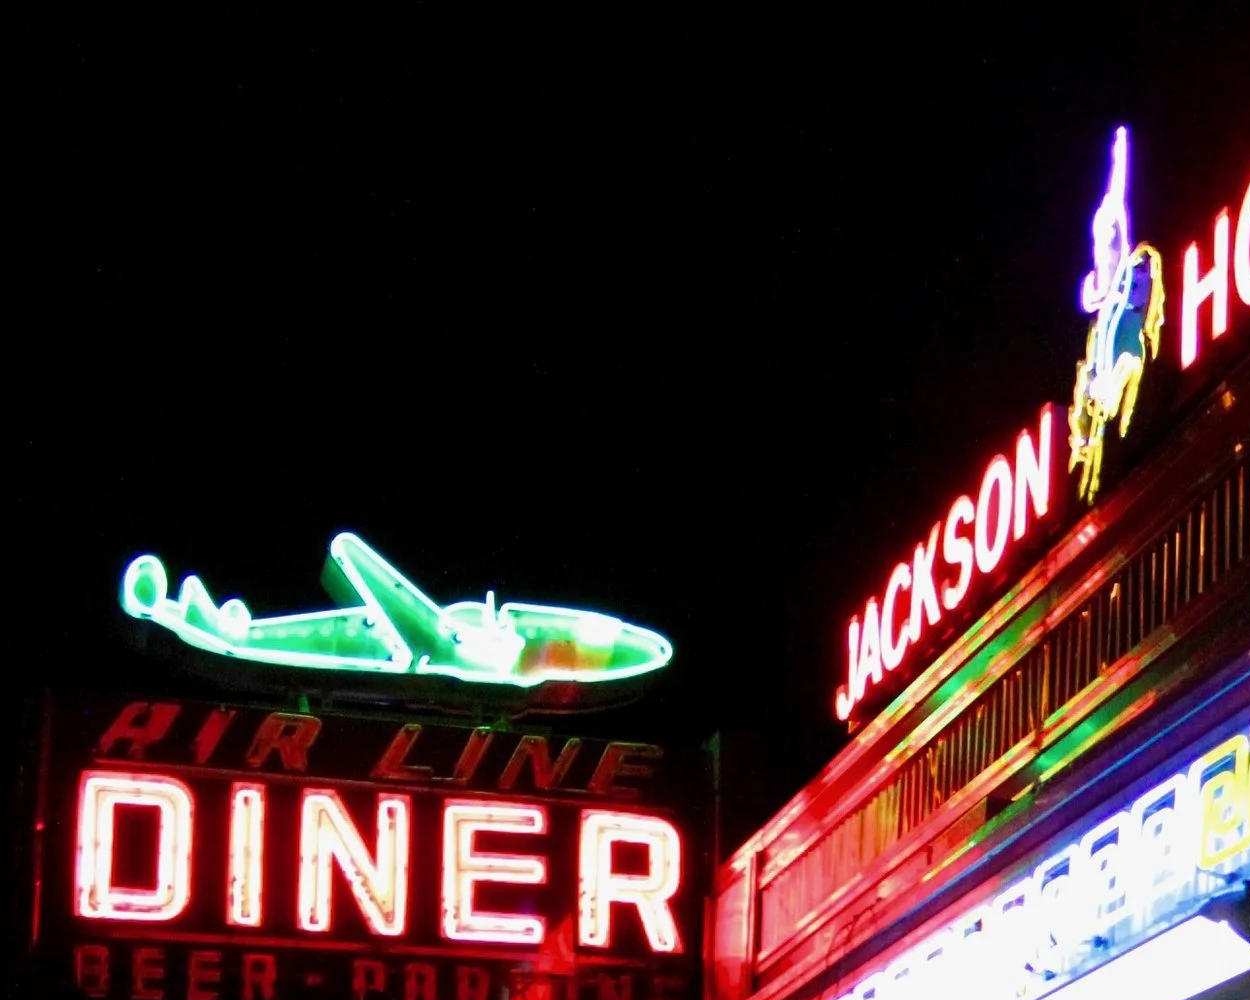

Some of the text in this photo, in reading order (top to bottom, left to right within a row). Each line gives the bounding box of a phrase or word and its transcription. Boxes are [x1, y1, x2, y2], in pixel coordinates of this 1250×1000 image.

[836, 401, 1056, 721] JACKSON
[98, 699, 664, 795] AIR LINE
[75, 768, 685, 955] DINER
